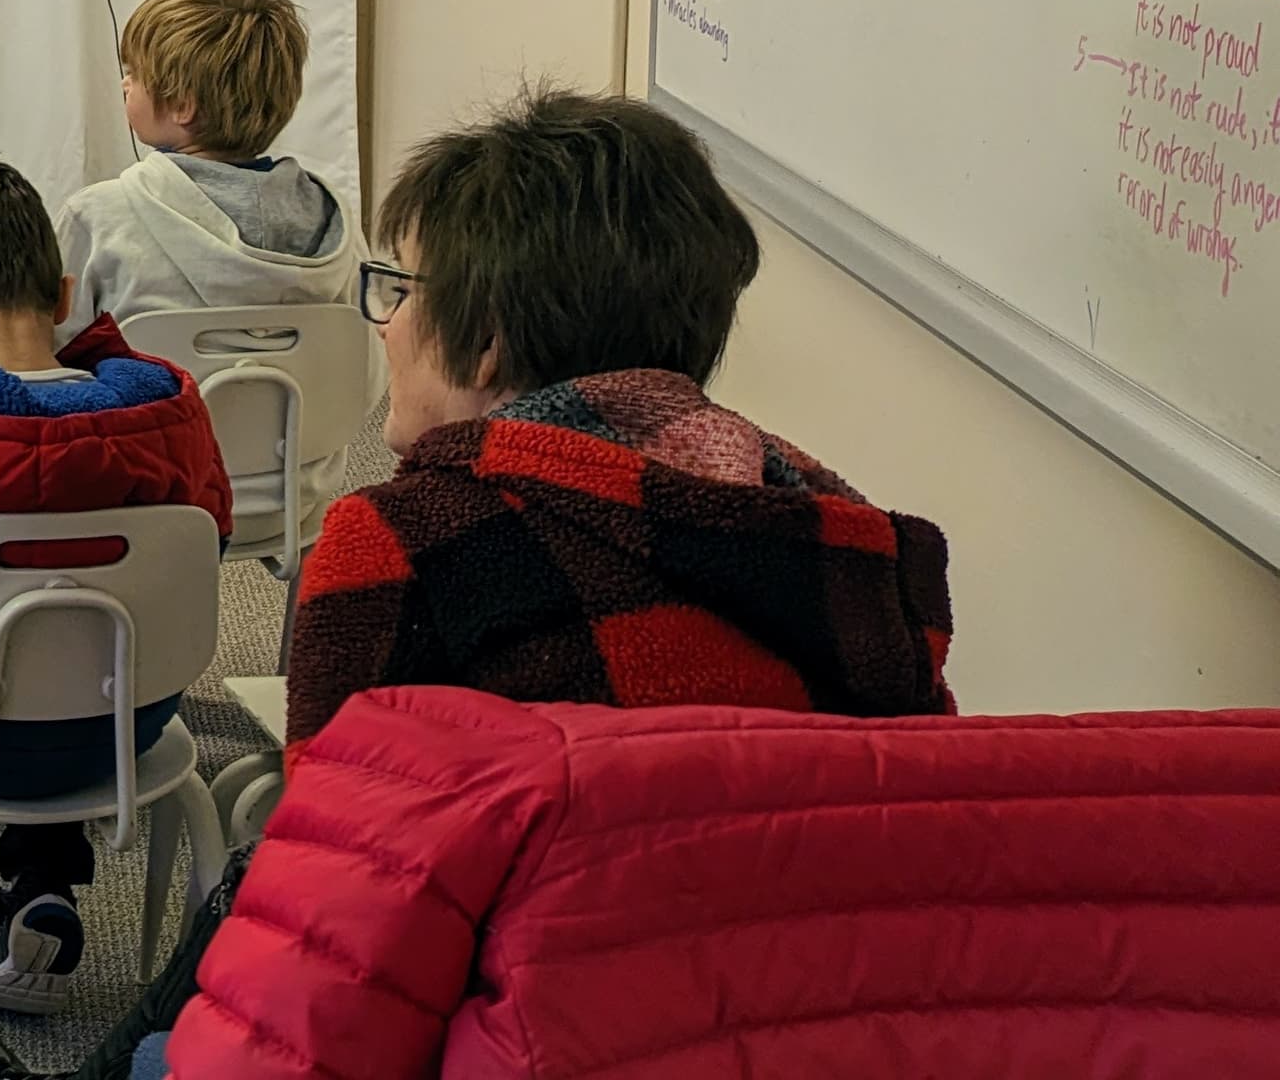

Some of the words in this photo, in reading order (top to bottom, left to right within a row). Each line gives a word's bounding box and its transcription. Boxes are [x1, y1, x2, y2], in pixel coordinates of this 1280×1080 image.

[1074, 34, 1088, 72] 5
[1127, 62, 1149, 100] It
[1153, 67, 1168, 102] is
[1170, 81, 1202, 121] not
[1152, 3, 1165, 39] is
[1169, 3, 1201, 51] not
[1201, 22, 1262, 81] proud
[1118, 106, 1134, 153] it
[1136, 127, 1151, 163] is
[1153, 133, 1183, 175] not
[1181, 141, 1225, 228] easily
[1118, 172, 1168, 235] record
[1168, 199, 1187, 240] of
